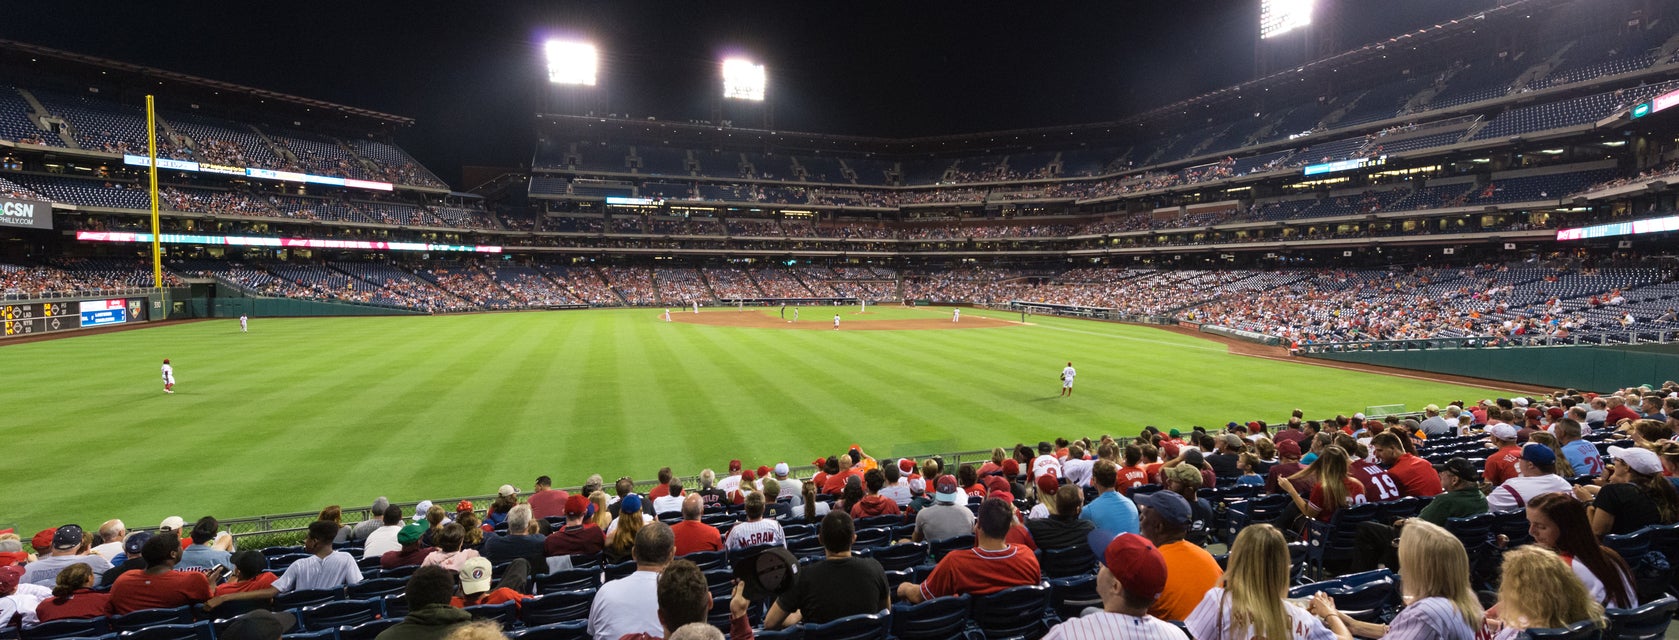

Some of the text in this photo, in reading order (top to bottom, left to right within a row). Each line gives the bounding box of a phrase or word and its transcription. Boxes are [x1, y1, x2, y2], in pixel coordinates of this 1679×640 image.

[4, 202, 34, 217] CSN
[1125, 471, 1144, 480] BROWN
[1371, 474, 1399, 500] 19
[739, 532, 774, 547] McGRAW
